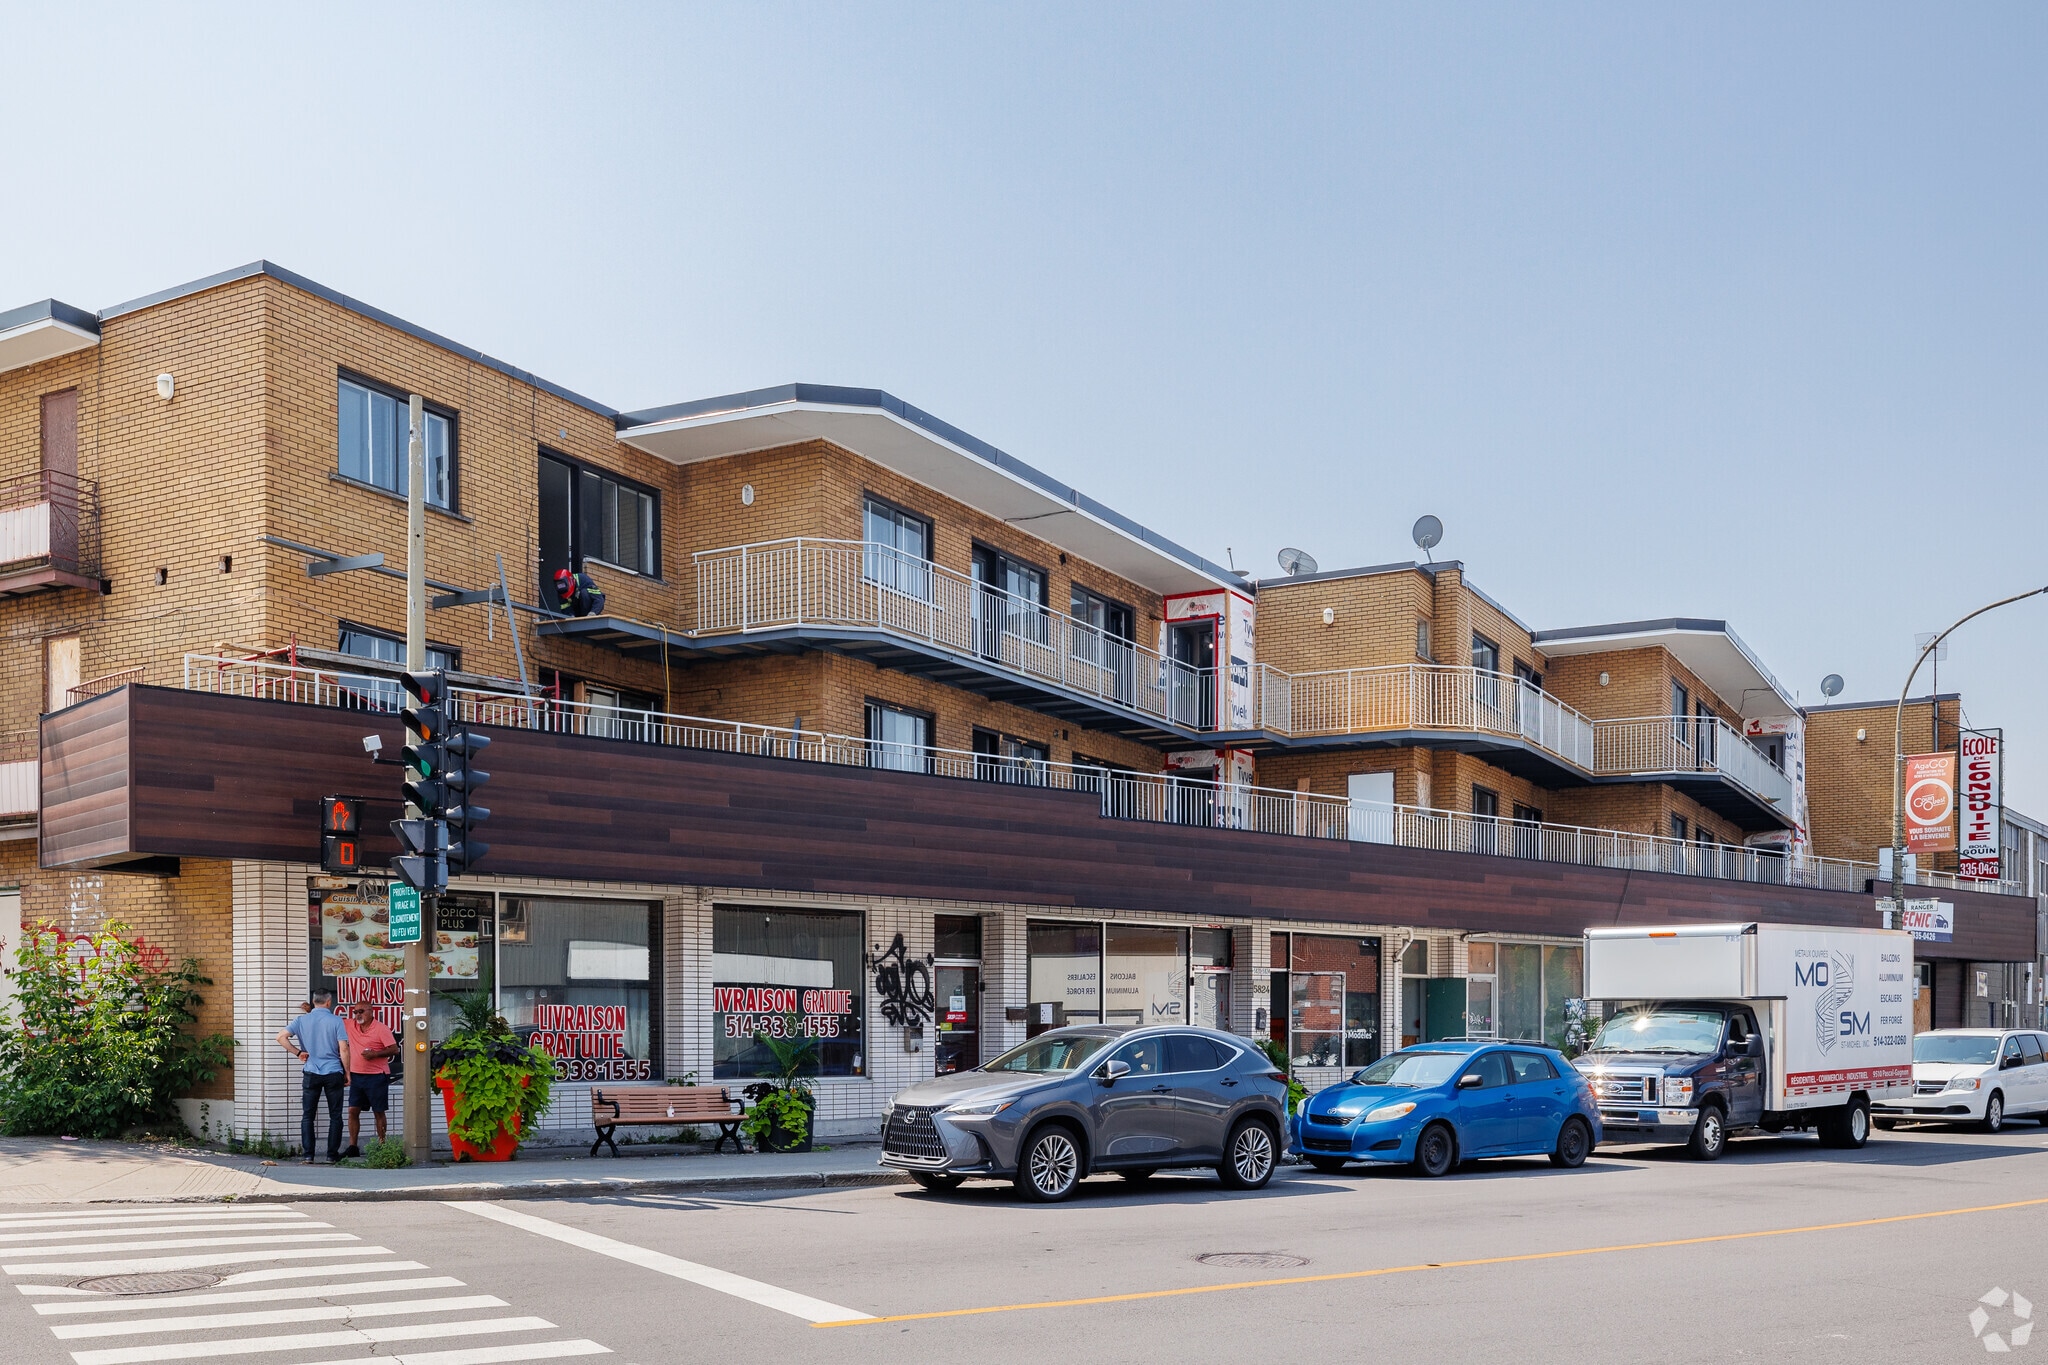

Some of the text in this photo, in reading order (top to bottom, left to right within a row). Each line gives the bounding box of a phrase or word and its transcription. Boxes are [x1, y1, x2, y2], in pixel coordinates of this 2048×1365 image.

[1962, 736, 1997, 757] ÉCOLE
[1914, 759, 1948, 770] AgaGO
[1968, 761, 1991, 842] CONDUITE
[1909, 827, 1923, 835] VOUS
[1962, 848, 1996, 856] GOUIN
[394, 900, 409, 910] VIRAGE
[410, 899, 416, 909] AU
[391, 912, 419, 924] CLIGNOTEMENT
[436, 908, 476, 918] ROPICO
[441, 919, 465, 928] PLUS
[1902, 912, 1932, 928] ECNIC
[392, 928, 398, 938] DU
[407, 926, 418, 936] VERT
[1881, 954, 1900, 962] BALCONS
[1796, 962, 1828, 986] MO
[1879, 974, 1903, 982] ALUMINIUM
[337, 977, 404, 1004] LIVRAISO
[1254, 985, 1270, 993] 5824
[714, 987, 851, 1014] IVRAISON GRATUITE
[1880, 994, 1902, 1002] ESCALIERS
[538, 1004, 626, 1031] LIVRAISON
[1840, 1011, 1870, 1036] SM
[1880, 1017, 1888, 1025] FER
[725, 1015, 839, 1038] 514-338-1555
[529, 1032, 624, 1058] GRATUITE
[1873, 1035, 1906, 1046] 514-322-0260
[1791, 1076, 1816, 1085] RÉSIDENTIEL
[1818, 1074, 1844, 1083] COMMERCIAL
[1847, 1071, 1868, 1080] INDUSTRIEL
